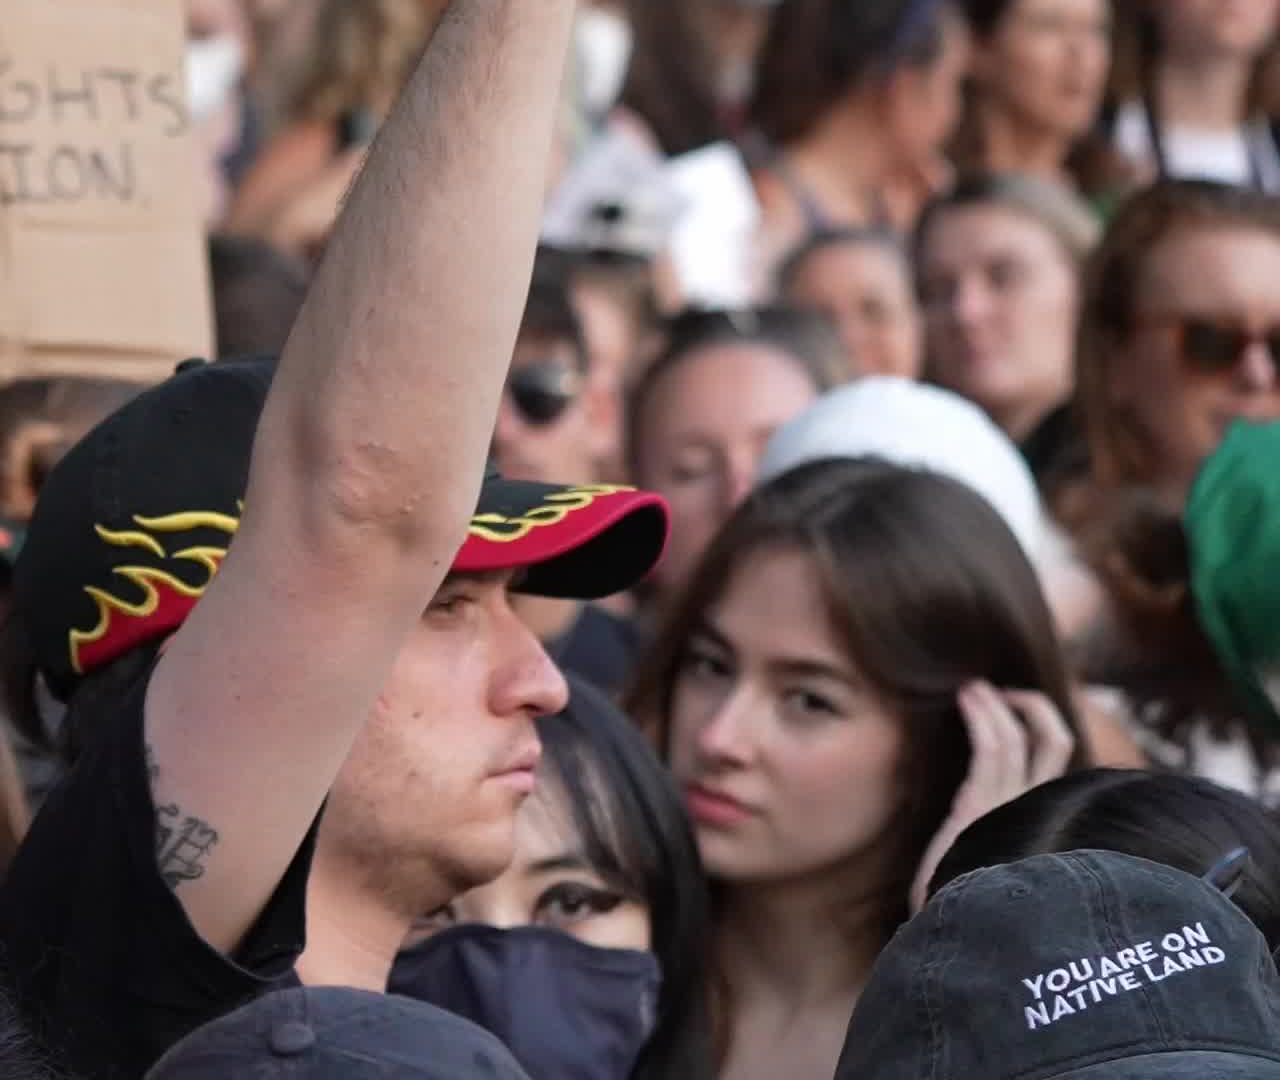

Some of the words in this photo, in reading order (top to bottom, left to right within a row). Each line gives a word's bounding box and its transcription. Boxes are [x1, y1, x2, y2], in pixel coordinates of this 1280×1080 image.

[1021, 958, 1094, 1000] YOU
[1100, 940, 1160, 978] ARE
[1161, 922, 1211, 953] ON
[1023, 971, 1141, 1030] NATIVE
[1142, 946, 1225, 982] LAND
